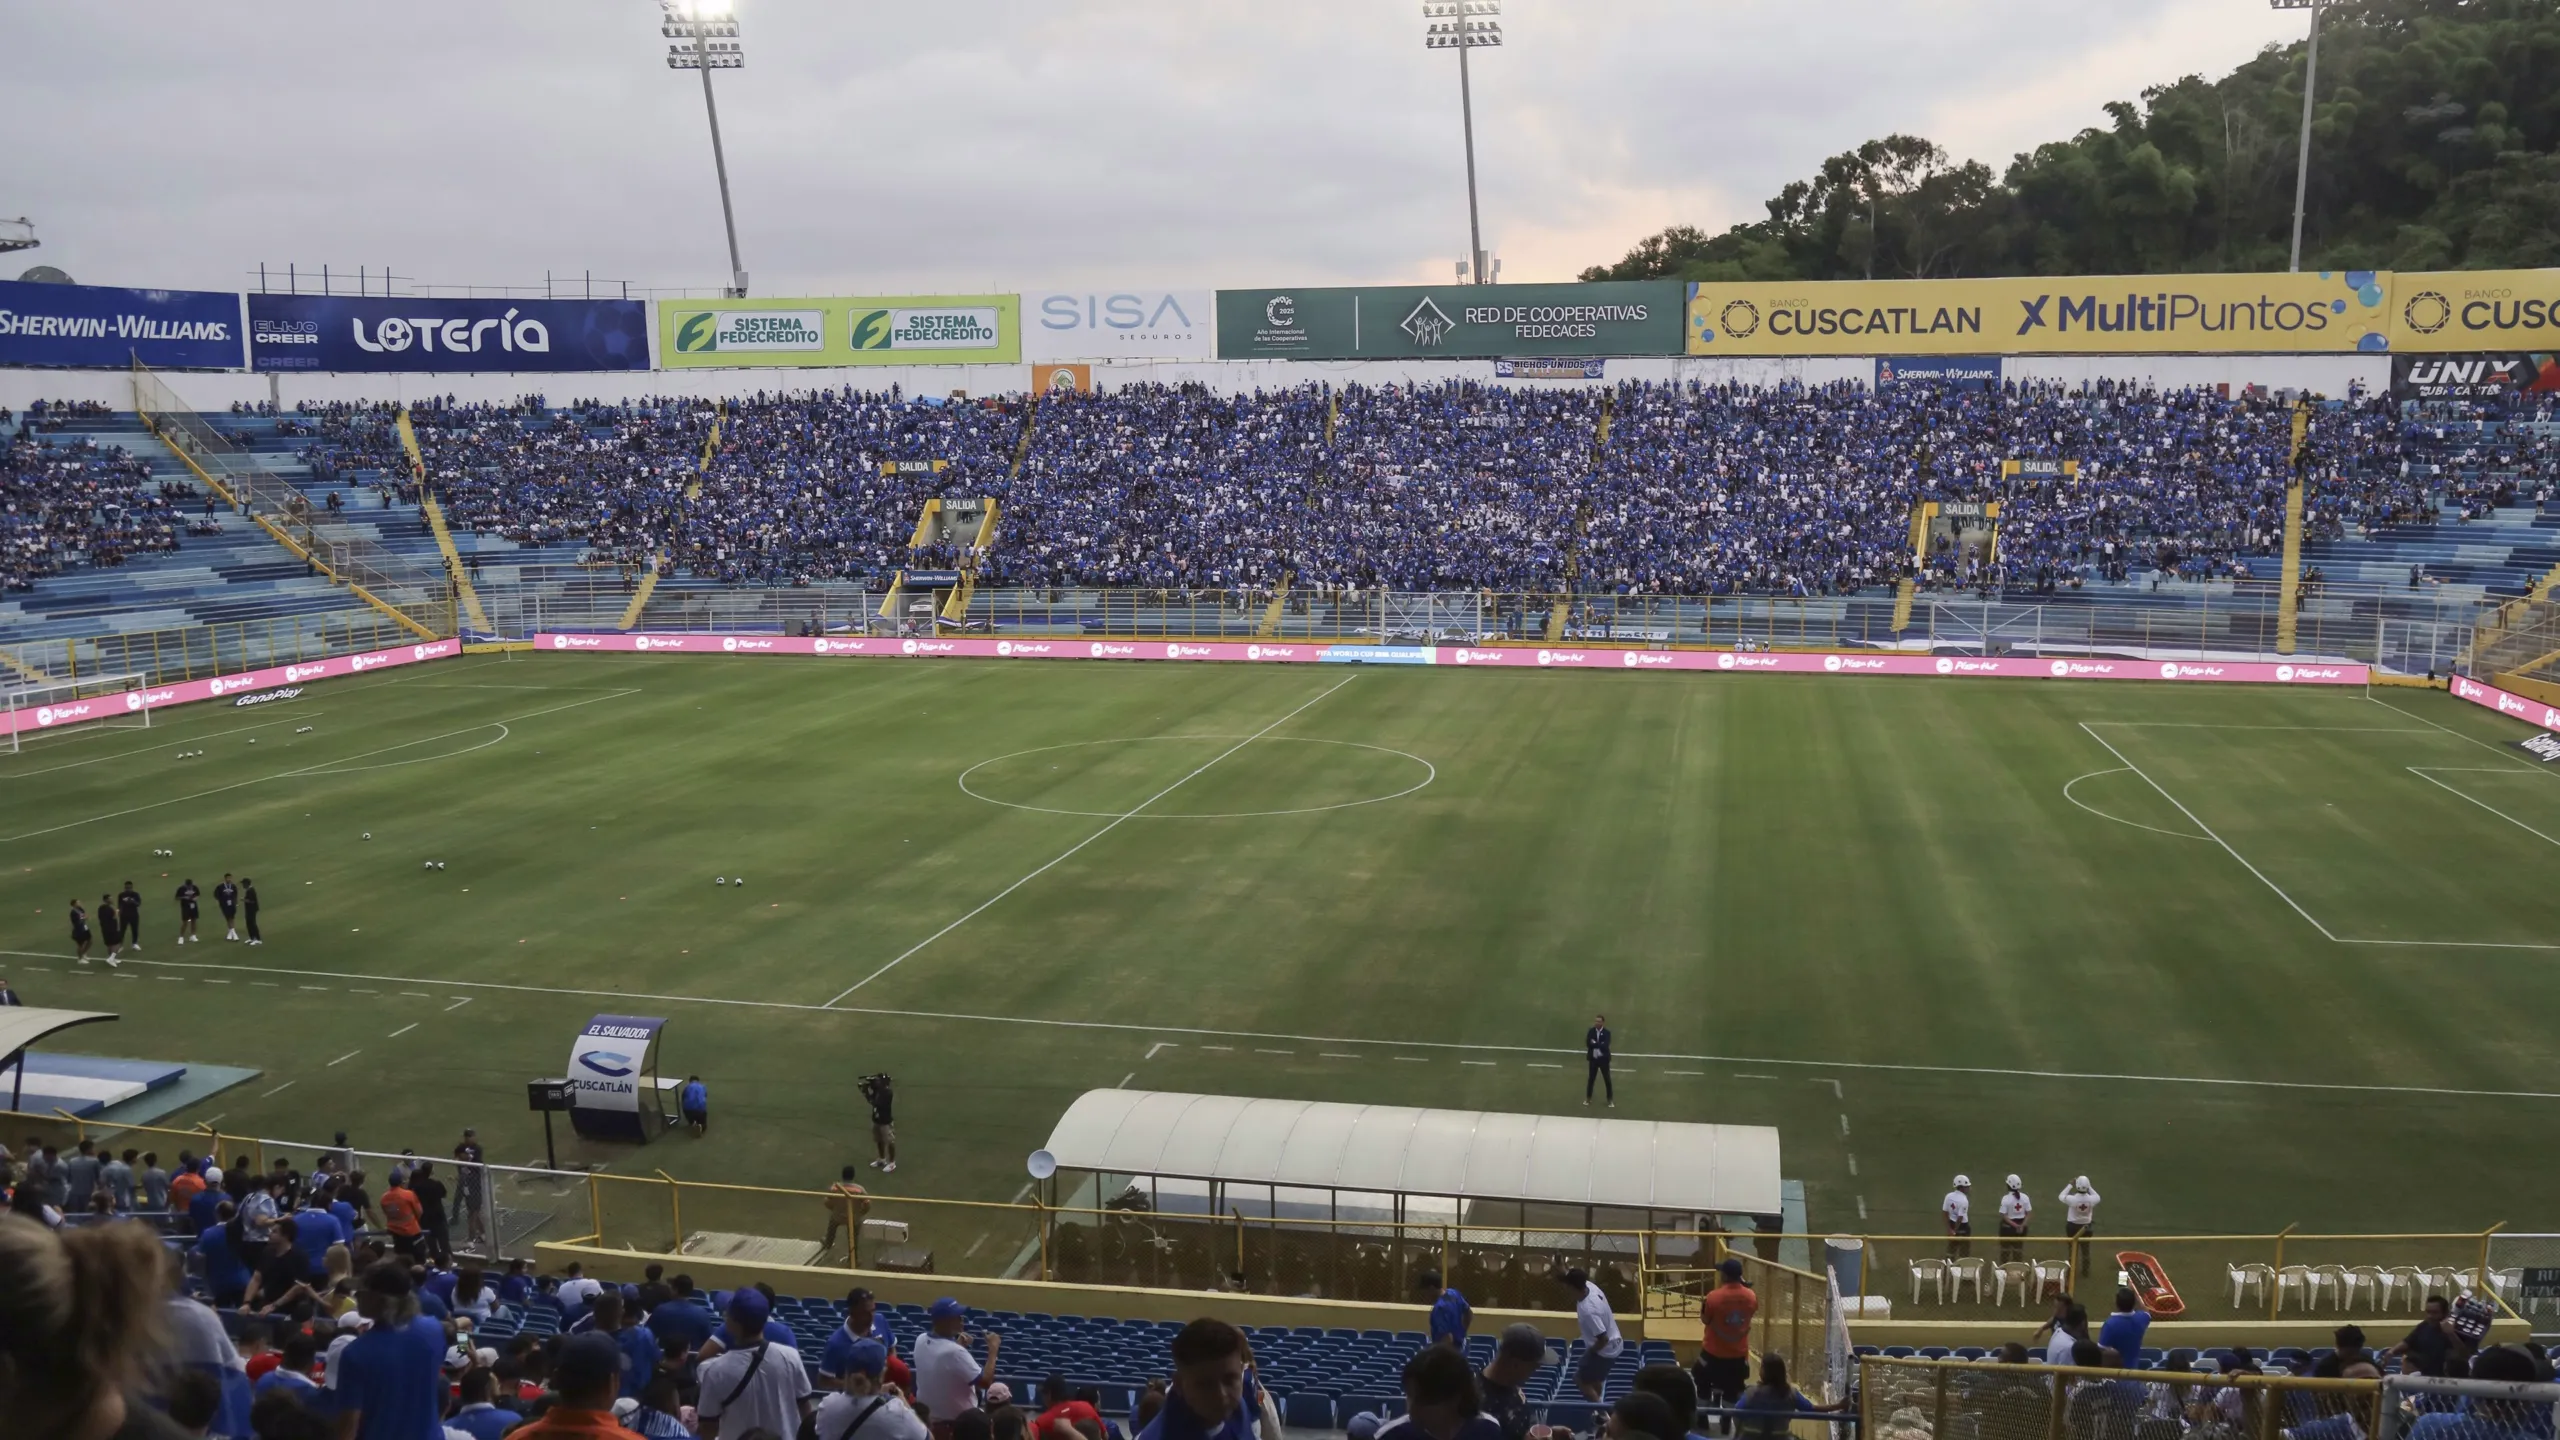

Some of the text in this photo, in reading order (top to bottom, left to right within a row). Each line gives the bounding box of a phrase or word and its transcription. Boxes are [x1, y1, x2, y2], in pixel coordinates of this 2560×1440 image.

[2464, 289, 2512, 299] BANCO
[1769, 298, 1809, 308] BANCO
[1040, 294, 1191, 330] SISA
[1465, 305, 1648, 323] RED DE COOPERATIVAS
[2058, 293, 2328, 331] MultiPuntos
[254, 320, 318, 333] ELIJO
[734, 318, 803, 331] SISTEMA
[909, 315, 978, 328] SISTEMA
[1768, 307, 1981, 335] CUSCATLAN
[894, 327, 993, 341] FEDECREDITO
[1515, 324, 1596, 338] FEDECACES
[256, 333, 318, 344] CREER
[720, 331, 819, 343] FEDECREDITO
[257, 357, 319, 368] CREER
[1551, 361, 1585, 369] UNIDOS
[900, 461, 929, 472] SALIDA
[2024, 461, 2058, 472] SALIDA
[946, 500, 977, 510] SALIDA
[1945, 504, 1980, 515] SALIDA
[1333, 650, 1358, 658] WORLD
[1469, 652, 1487, 660] Pizza
[1551, 653, 1585, 661] Pizza Hut
[1638, 654, 1673, 663] Pizza Hut
[1735, 656, 1778, 666] Pizza Hut
[1842, 659, 1885, 668] Pizza Hut
[1955, 661, 1999, 670] Pizza Hut
[2068, 663, 2094, 673] Pizza
[2179, 666, 2224, 675] Pizza Hut
[2295, 669, 2340, 678] Pizza Hut
[236, 687, 304, 706] GanaPlay
[588, 1025, 650, 1039] EL SALVADOR
